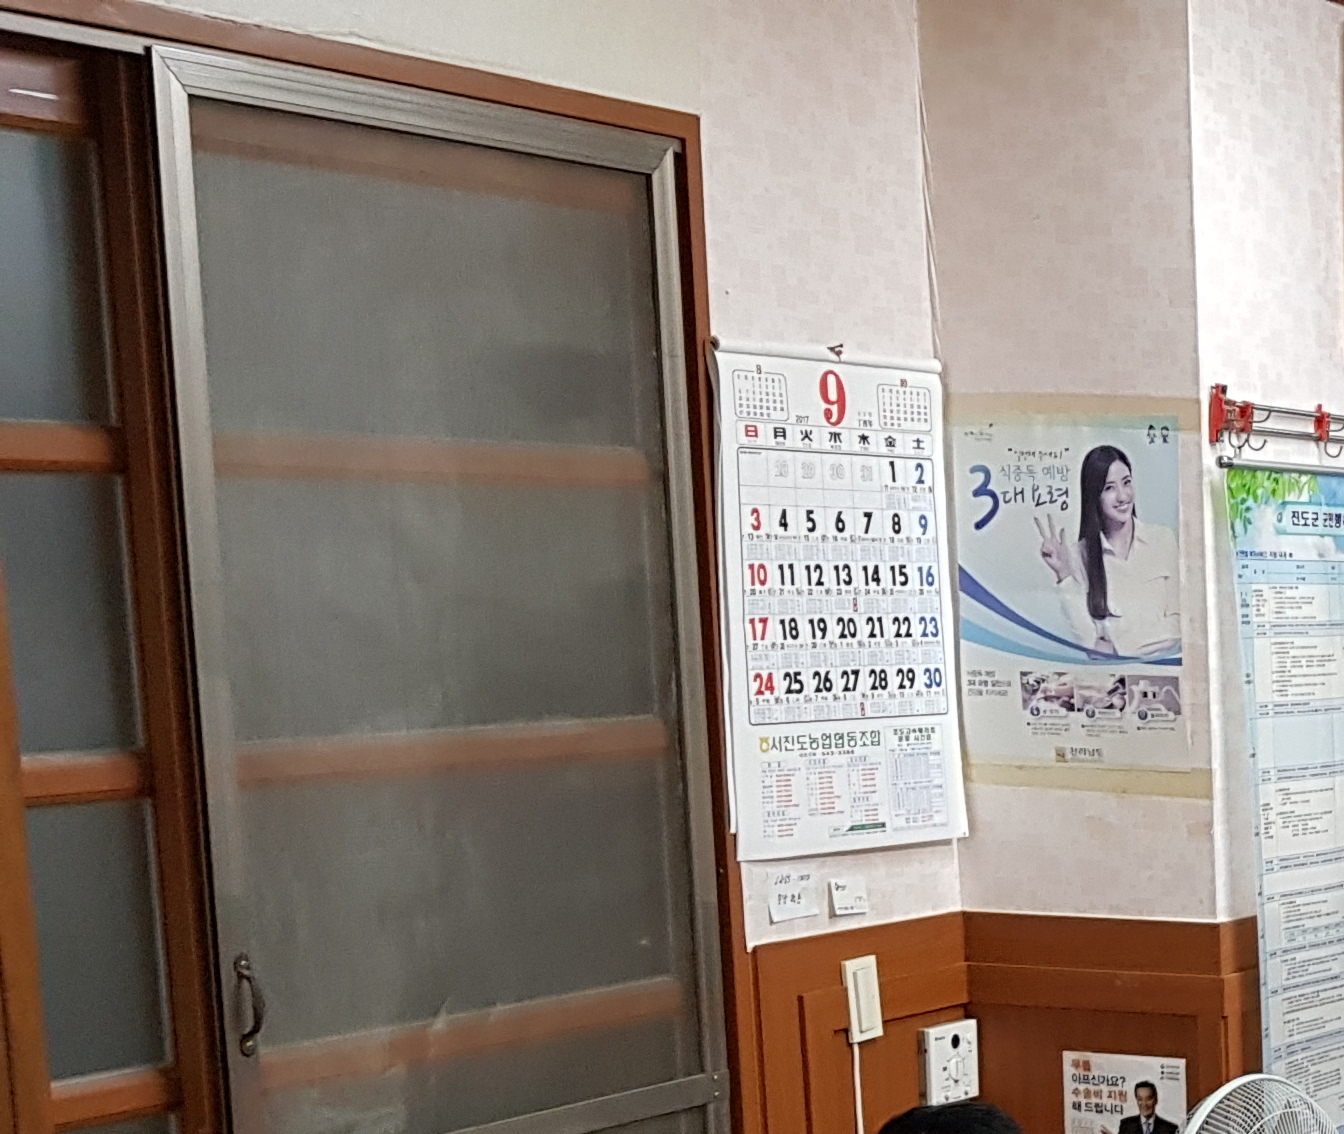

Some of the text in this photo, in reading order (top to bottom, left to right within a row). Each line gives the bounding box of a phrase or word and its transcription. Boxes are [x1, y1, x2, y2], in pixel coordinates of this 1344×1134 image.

[819, 370, 847, 427] 9
[744, 424, 758, 439] 日
[773, 427, 787, 441] 月
[800, 429, 813, 442] 火
[828, 431, 843, 444] 水
[884, 435, 897, 448] 金
[912, 438, 925, 450] 土
[889, 461, 896, 483] 1
[914, 463, 925, 485] 2
[1000, 464, 1070, 483] 식중독 예방
[750, 507, 928, 535] 3 4 5 6 7 8 9
[1291, 510, 1319, 527] 진도군
[748, 563, 935, 587] 10 11 12 13 14 15 16
[749, 616, 939, 641] 17 18 19 20 21 22 23
[753, 672, 775, 696] 24
[783, 671, 804, 694] 25
[812, 670, 833, 693] 26
[840, 669, 861, 692] 27
[868, 668, 888, 690] 28
[895, 668, 916, 690] 29
[923, 667, 942, 689] 30
[771, 730, 881, 752] 서진도농업협동조합
[1071, 1072, 1126, 1088] 아프신가요?
